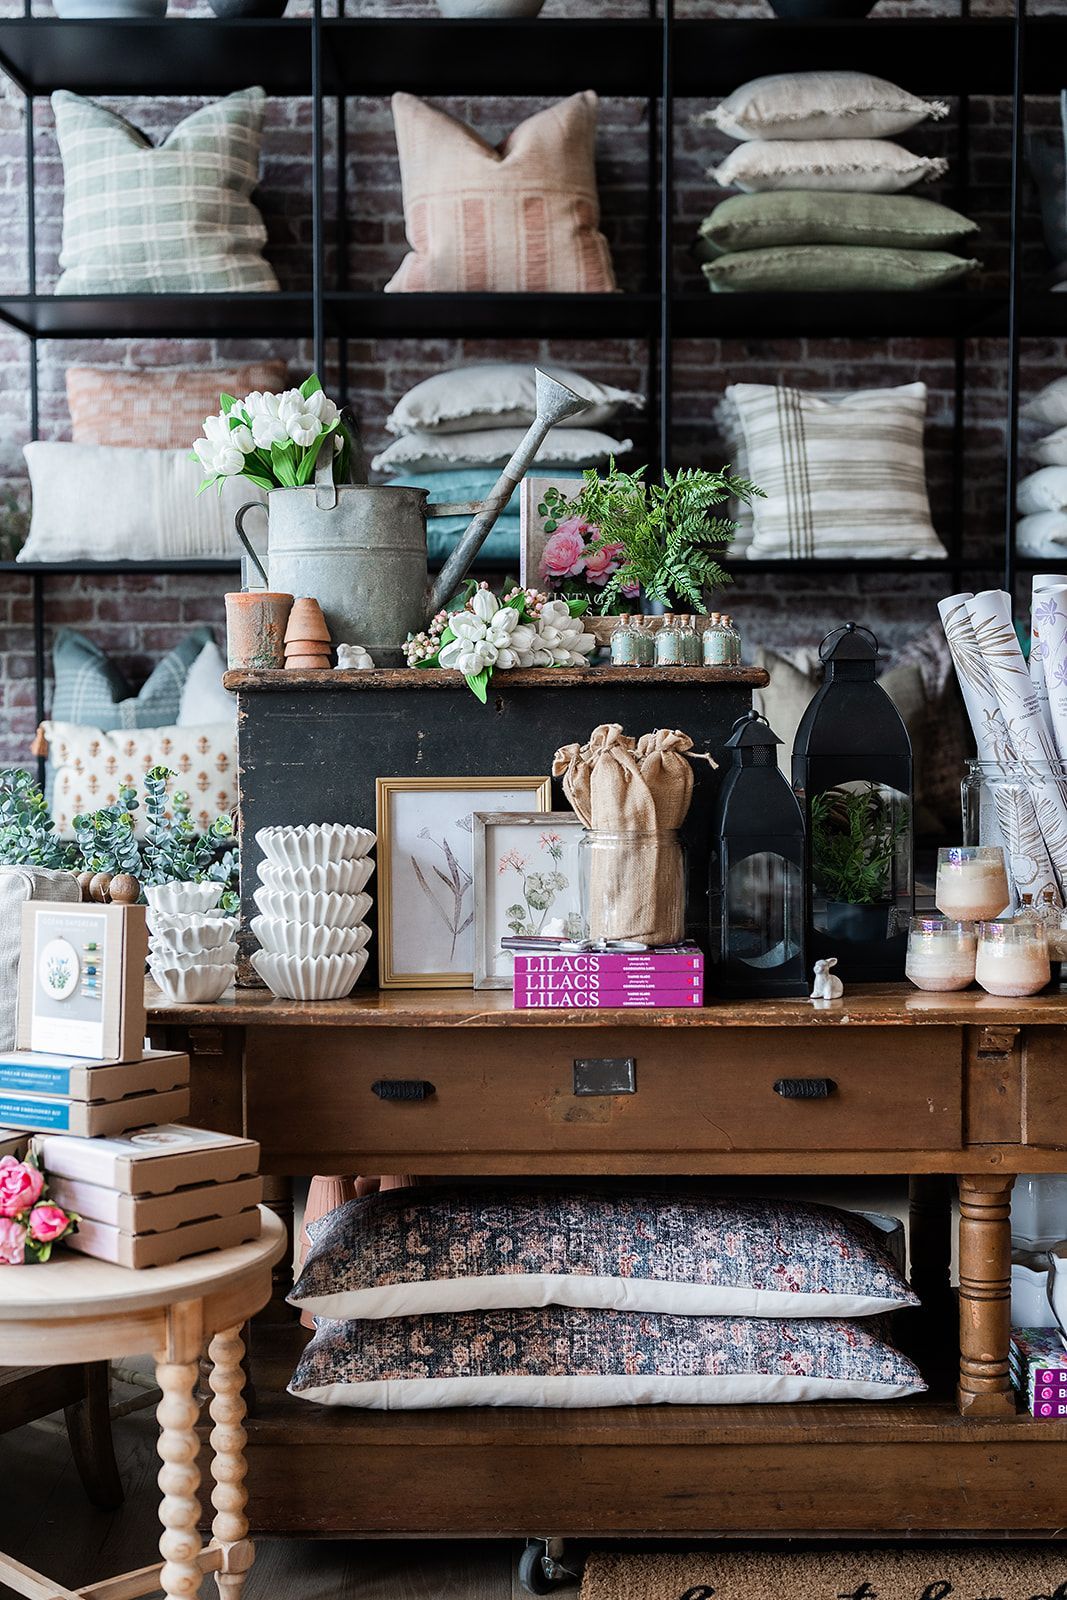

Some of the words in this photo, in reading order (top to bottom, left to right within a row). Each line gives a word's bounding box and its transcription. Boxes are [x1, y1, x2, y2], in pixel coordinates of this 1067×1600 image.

[547, 592, 615, 605] INTAG
[525, 956, 600, 972] LILACS
[525, 974, 600, 990] LILACS
[525, 991, 600, 1007] LILACS
